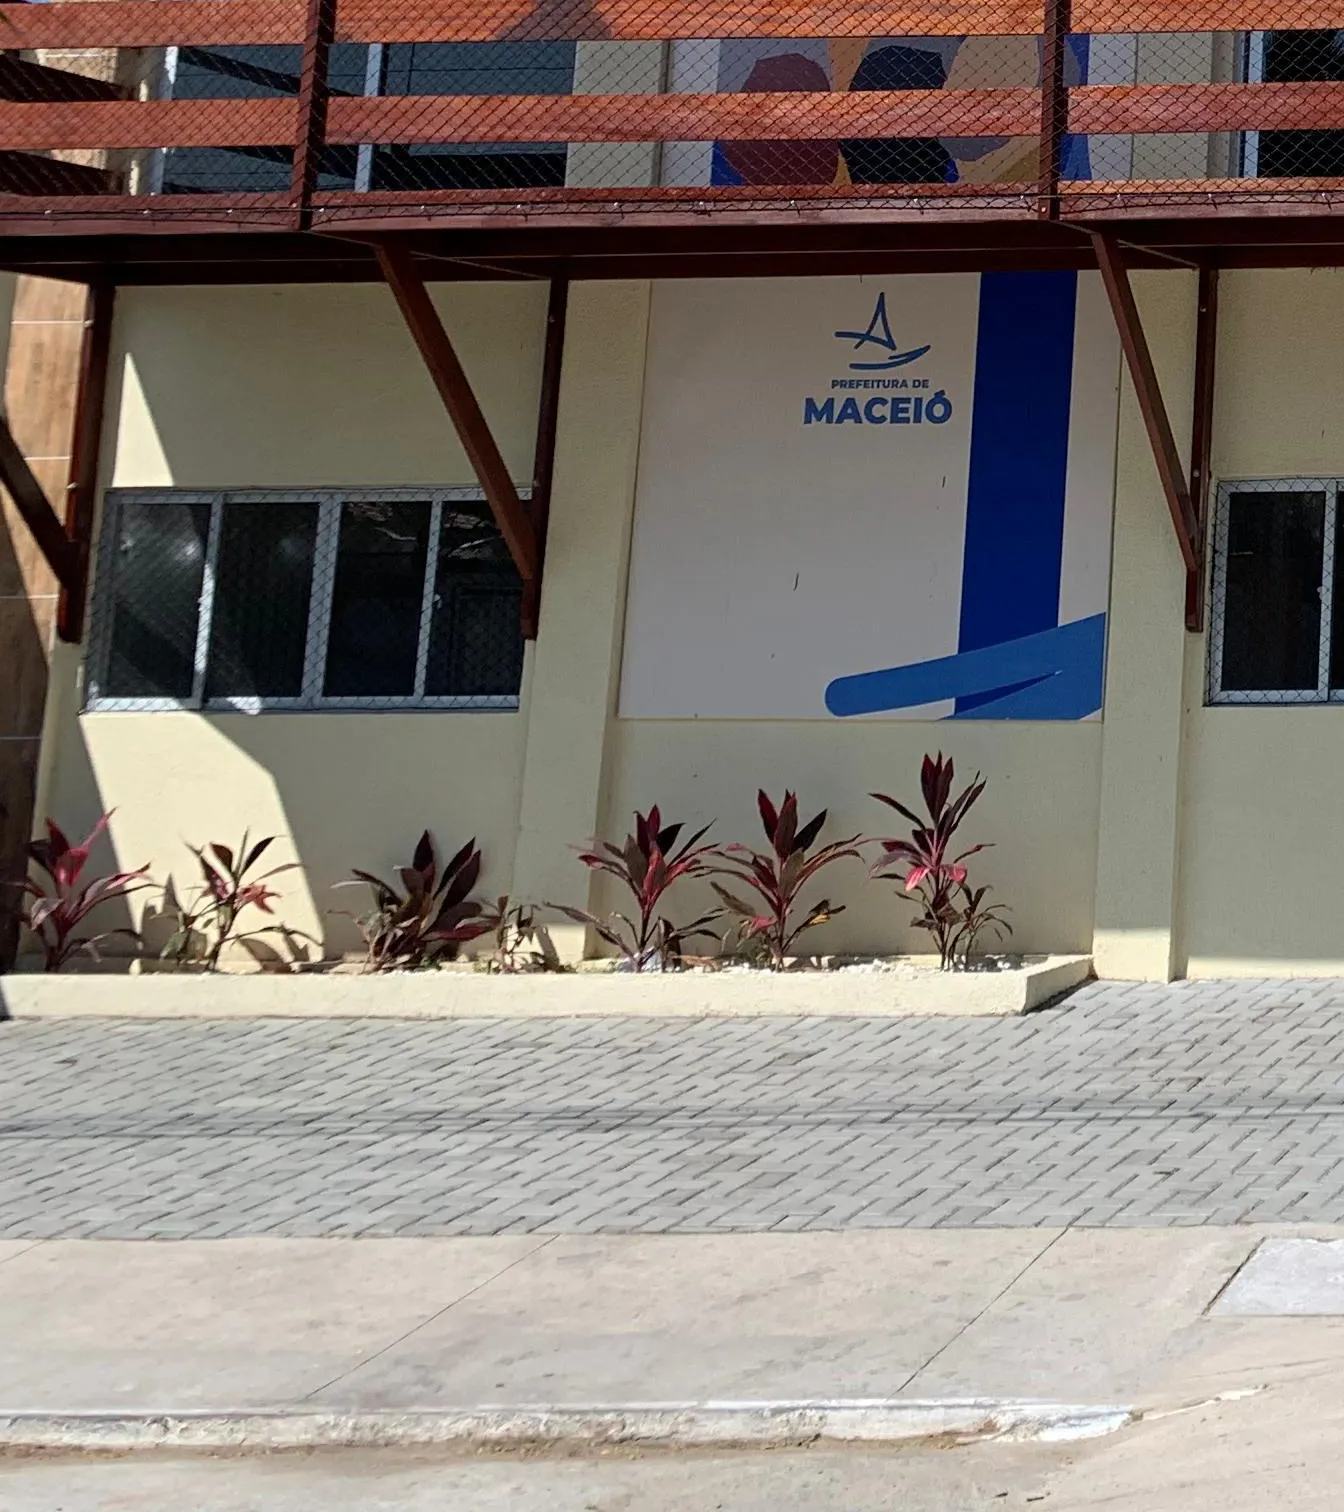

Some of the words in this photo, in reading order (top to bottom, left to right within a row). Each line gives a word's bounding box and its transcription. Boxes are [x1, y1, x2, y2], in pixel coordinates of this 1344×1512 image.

[831, 379, 908, 389] PREFEITURA
[911, 378, 930, 389] DE
[803, 389, 953, 425] MACEIÓ
